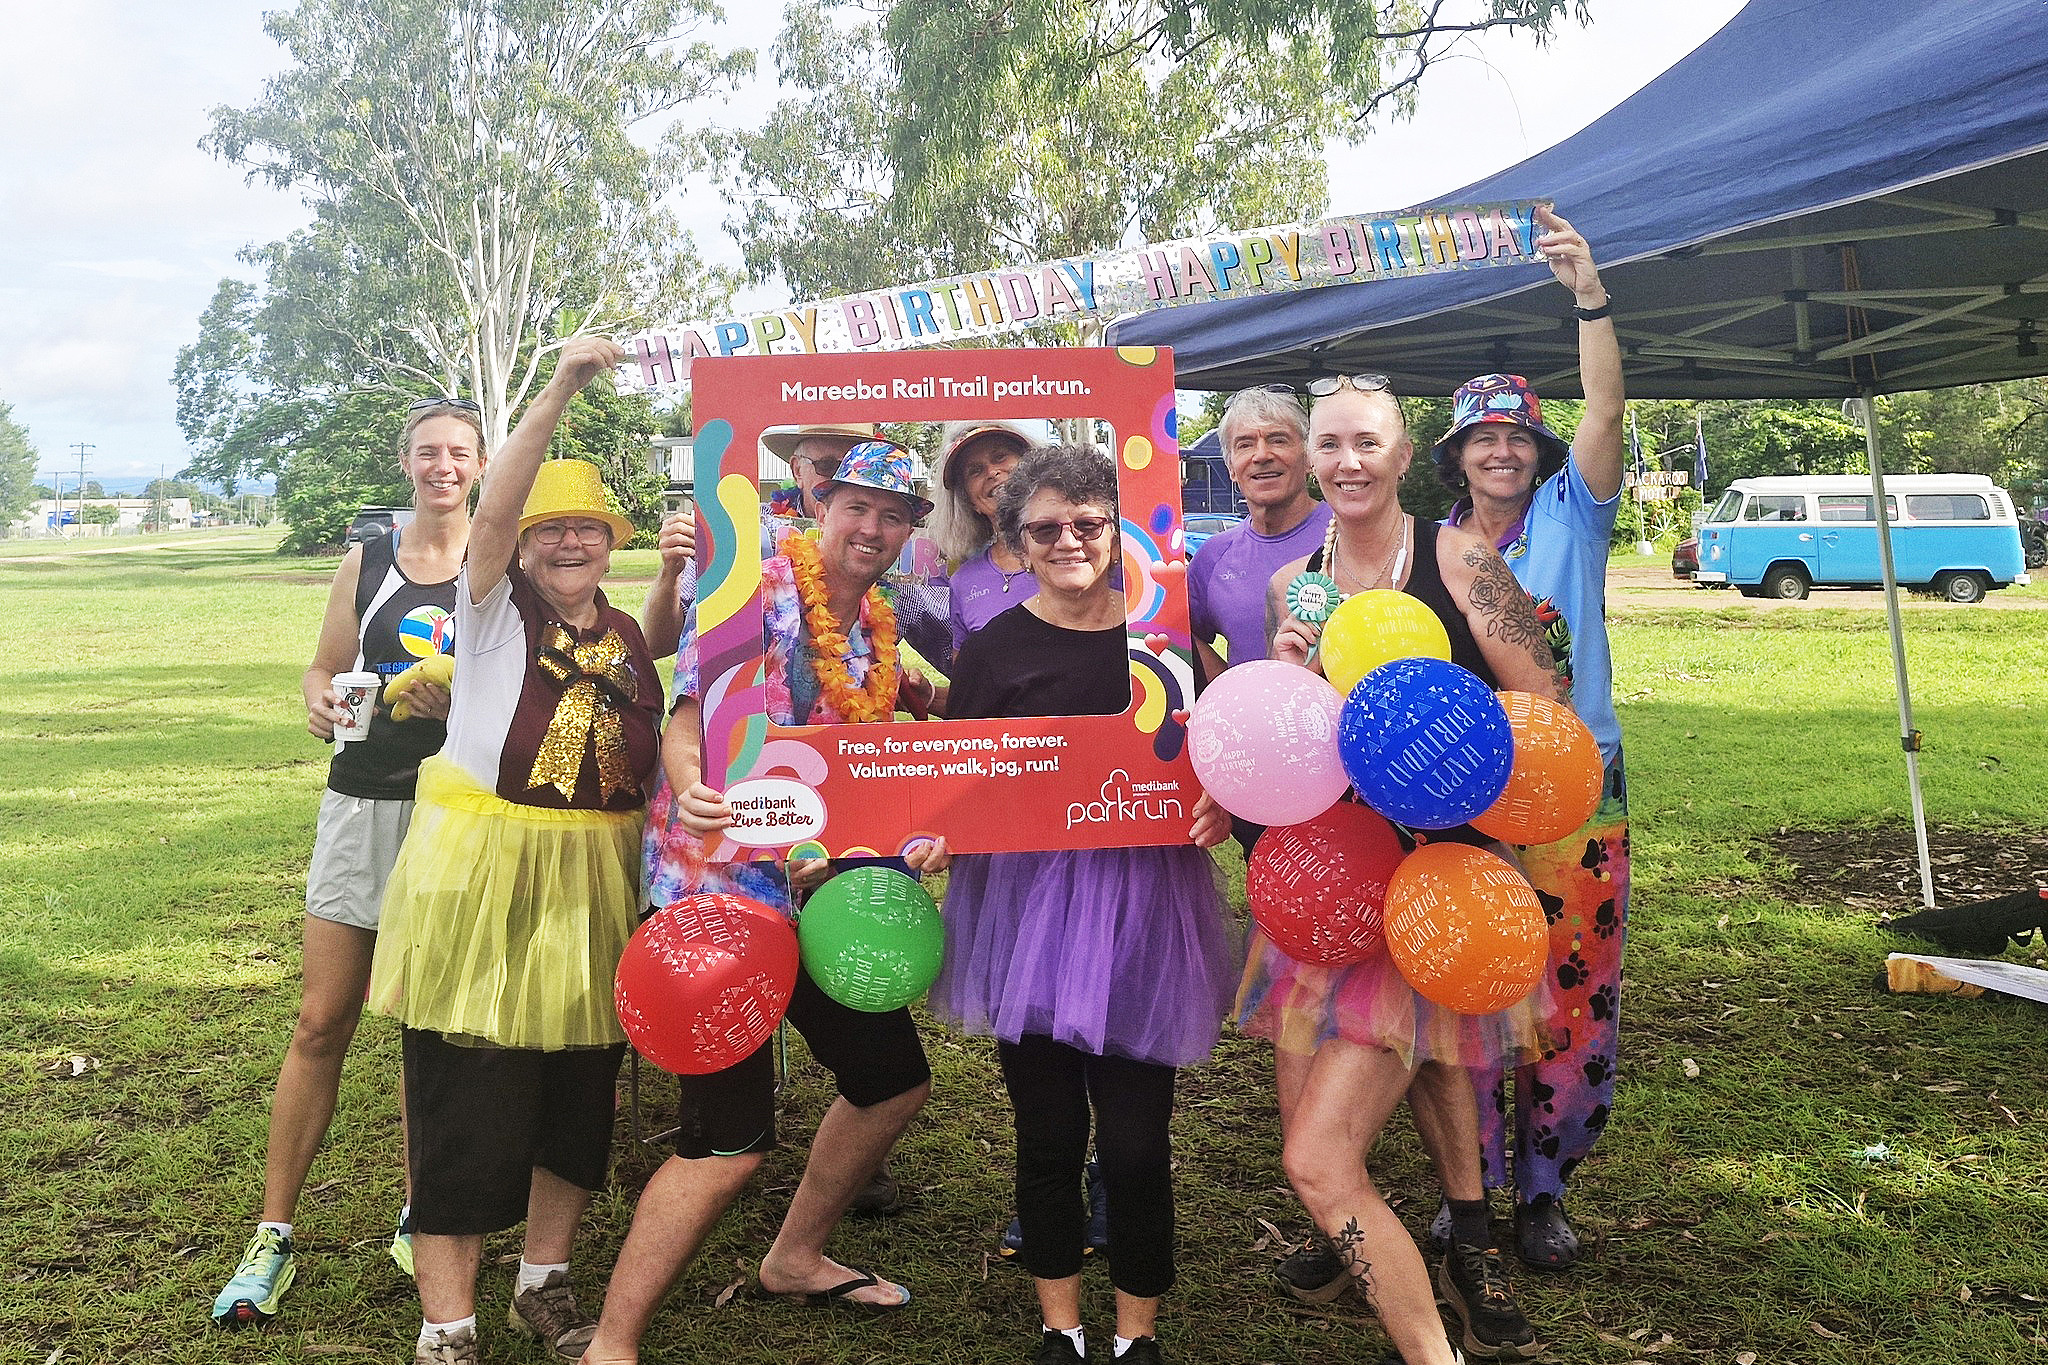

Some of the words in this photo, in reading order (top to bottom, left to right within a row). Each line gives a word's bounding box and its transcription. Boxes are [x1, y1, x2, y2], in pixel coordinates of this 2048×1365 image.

[635, 308, 817, 385] HAPPY
[841, 260, 1098, 347] BIRTHDAY
[1137, 231, 1302, 300] HAPPY
[1320, 207, 1537, 277] BIRTHDAY
[780, 378, 887, 402] Mareeba
[891, 376, 935, 399] Rail
[938, 375, 988, 398] Trail
[993, 374, 1092, 402] parkrun.
[1272, 710, 1288, 739] HAPPY
[837, 738, 881, 757] Free,
[884, 736, 910, 755] for
[912, 736, 999, 755] everyone,
[1001, 733, 1068, 750] forever.
[1222, 749, 1246, 761] HAPPY
[1385, 703, 1476, 788] BIRTHDAY
[848, 761, 938, 779] Volunteer,
[941, 757, 988, 777] walk,
[989, 757, 1023, 778] jog,
[1025, 756, 1060, 773] run!
[1131, 780, 1180, 792] medibank
[1423, 742, 1486, 800] HAPPY
[730, 812, 763, 828] Live
[765, 810, 814, 827] Better
[731, 795, 797, 811] medibank
[1065, 784, 1184, 830] parkrun
[1266, 848, 1302, 889] HAPPY
[1277, 826, 1331, 882] BIRTHDAY
[672, 904, 703, 943] HAPPY
[1389, 887, 1438, 941] BIRTHDAY
[1404, 917, 1441, 955] HAPPY
